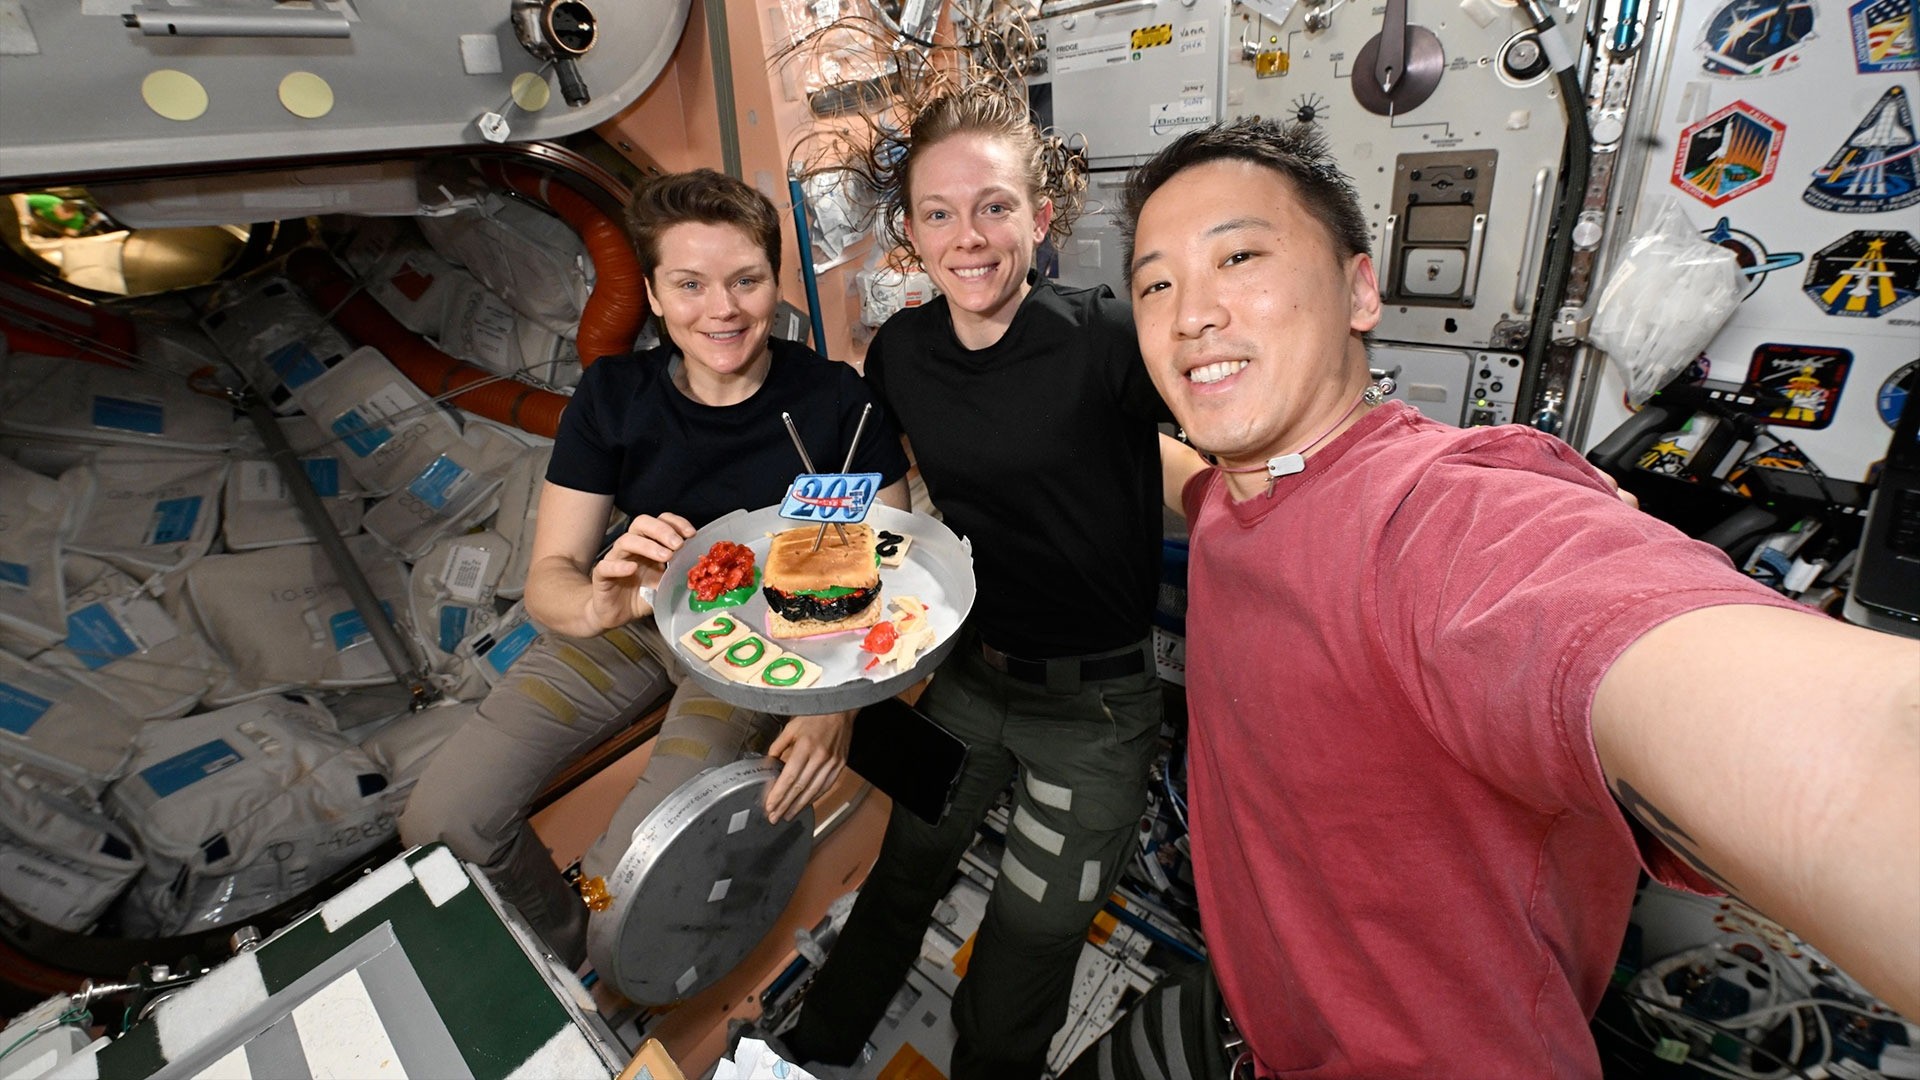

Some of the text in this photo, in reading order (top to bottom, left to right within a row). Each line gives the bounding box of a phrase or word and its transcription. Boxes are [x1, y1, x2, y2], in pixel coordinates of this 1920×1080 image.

[1056, 43, 1079, 54] FRIDGE
[790, 476, 872, 519] 200
[691, 616, 806, 687] 200
